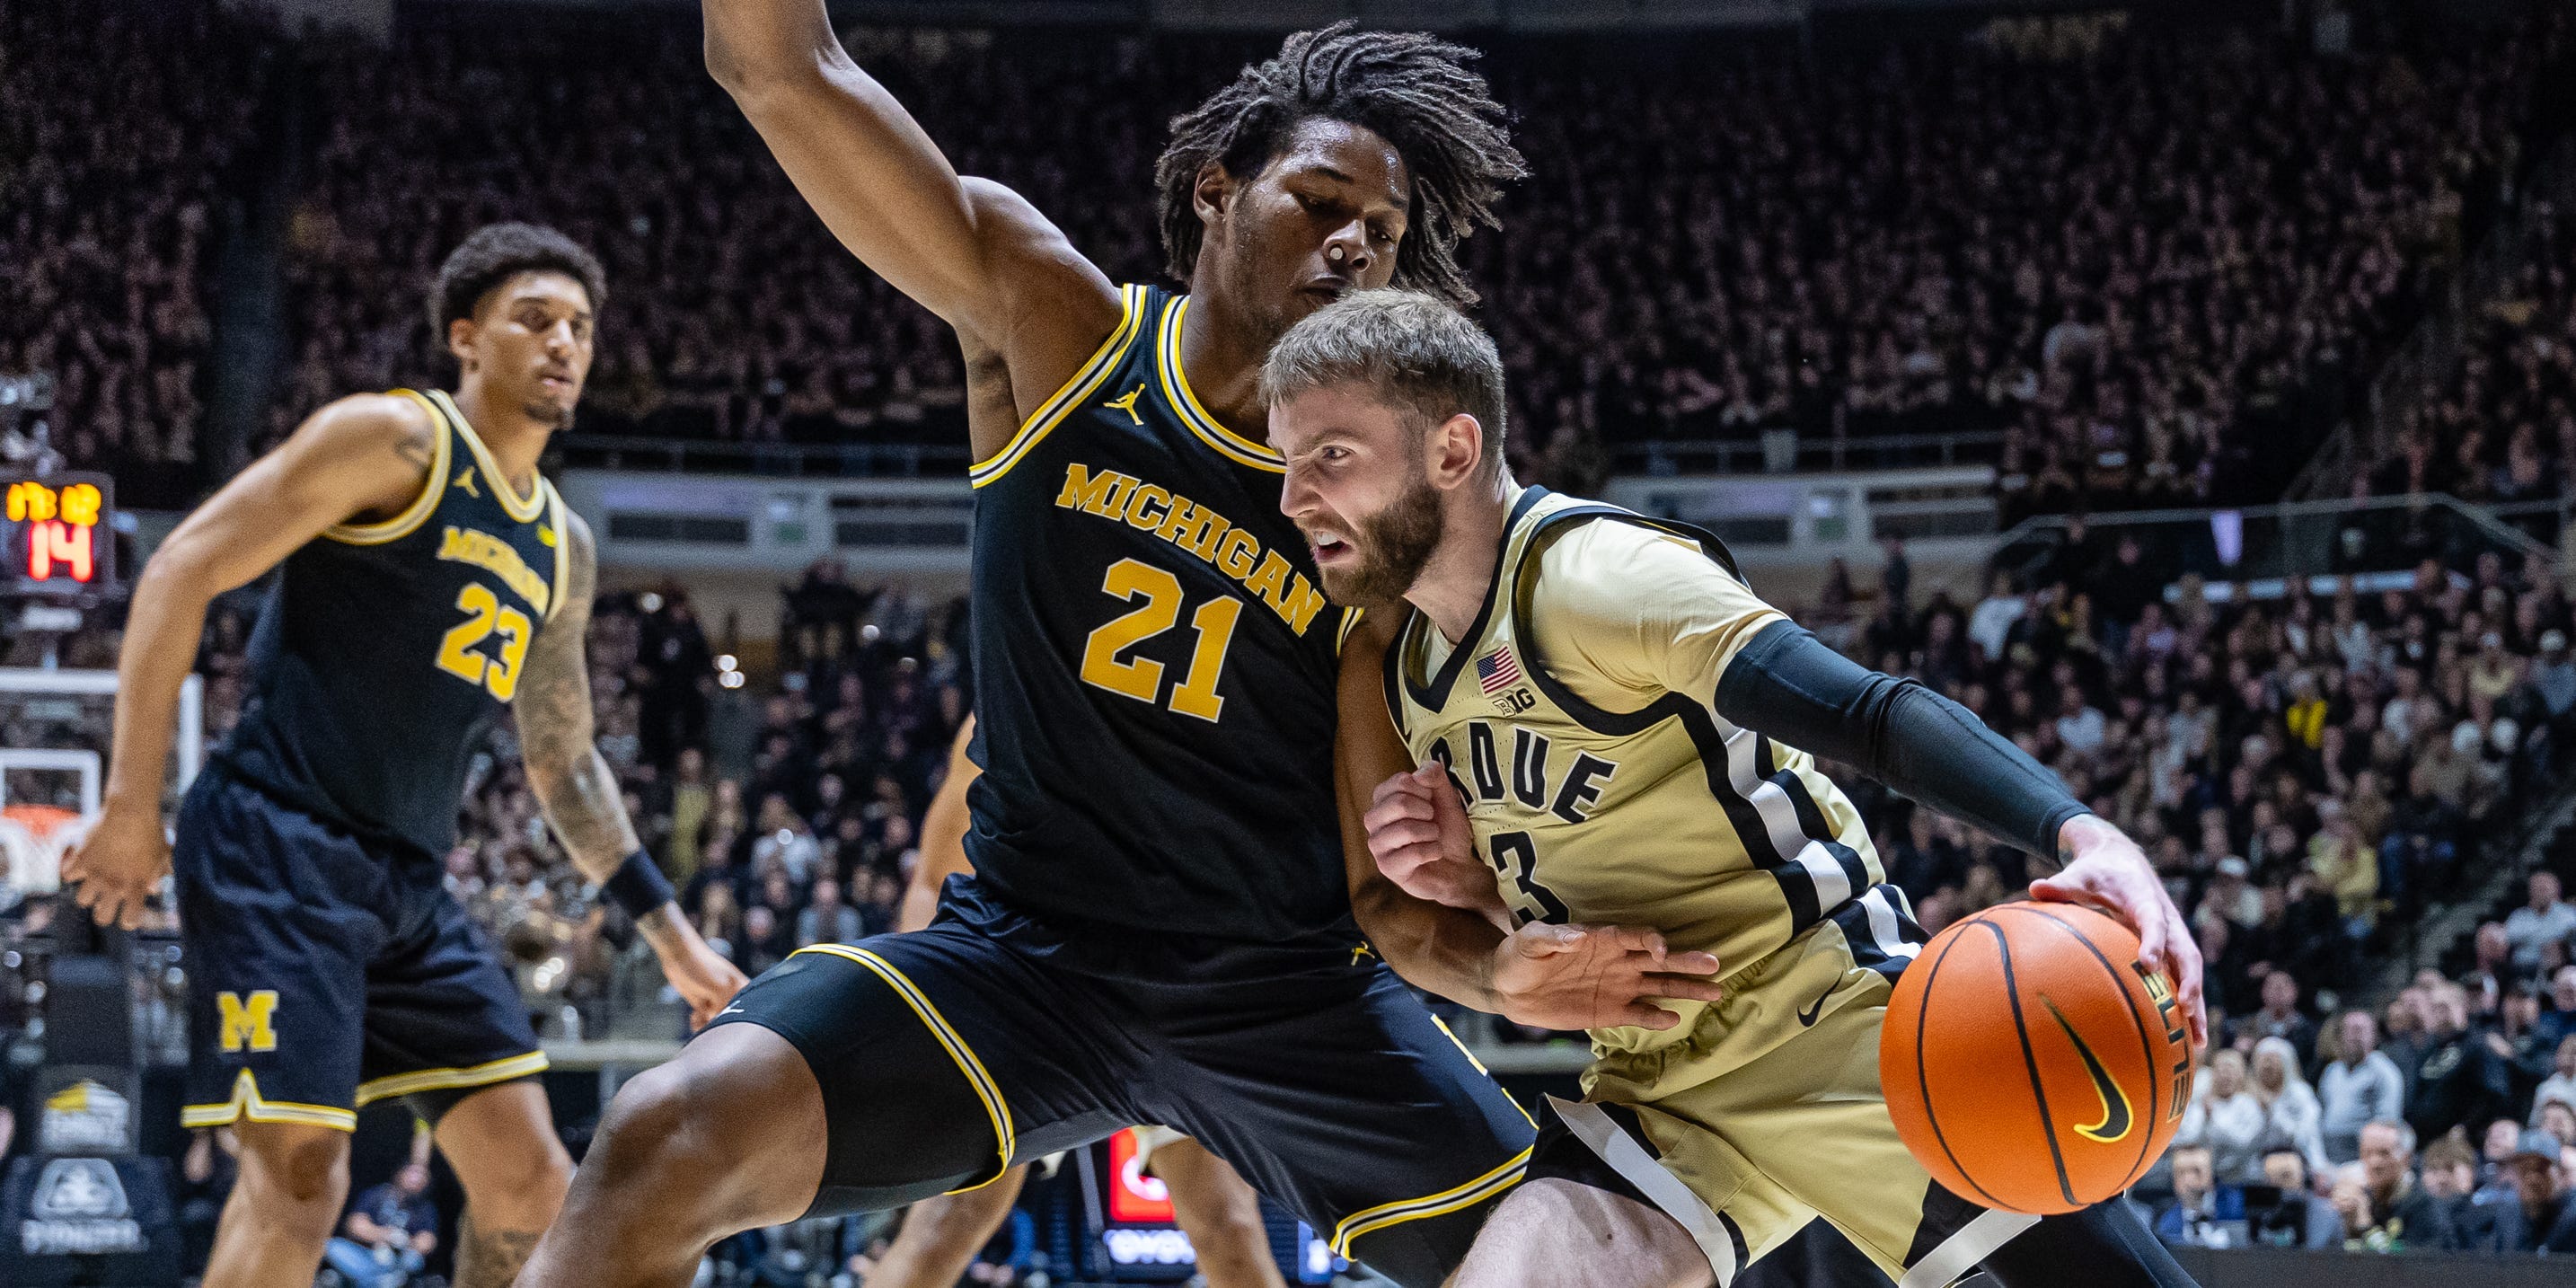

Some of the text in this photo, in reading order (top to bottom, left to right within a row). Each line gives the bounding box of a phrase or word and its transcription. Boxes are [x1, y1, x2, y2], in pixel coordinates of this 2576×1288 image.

[28, 520, 93, 581] 14
[1054, 463, 1326, 638] MICHIGAN
[435, 581, 533, 703] 23
[1080, 557, 1244, 724] 21
[1429, 720, 1620, 825] RDUE
[216, 990, 278, 1053] M
